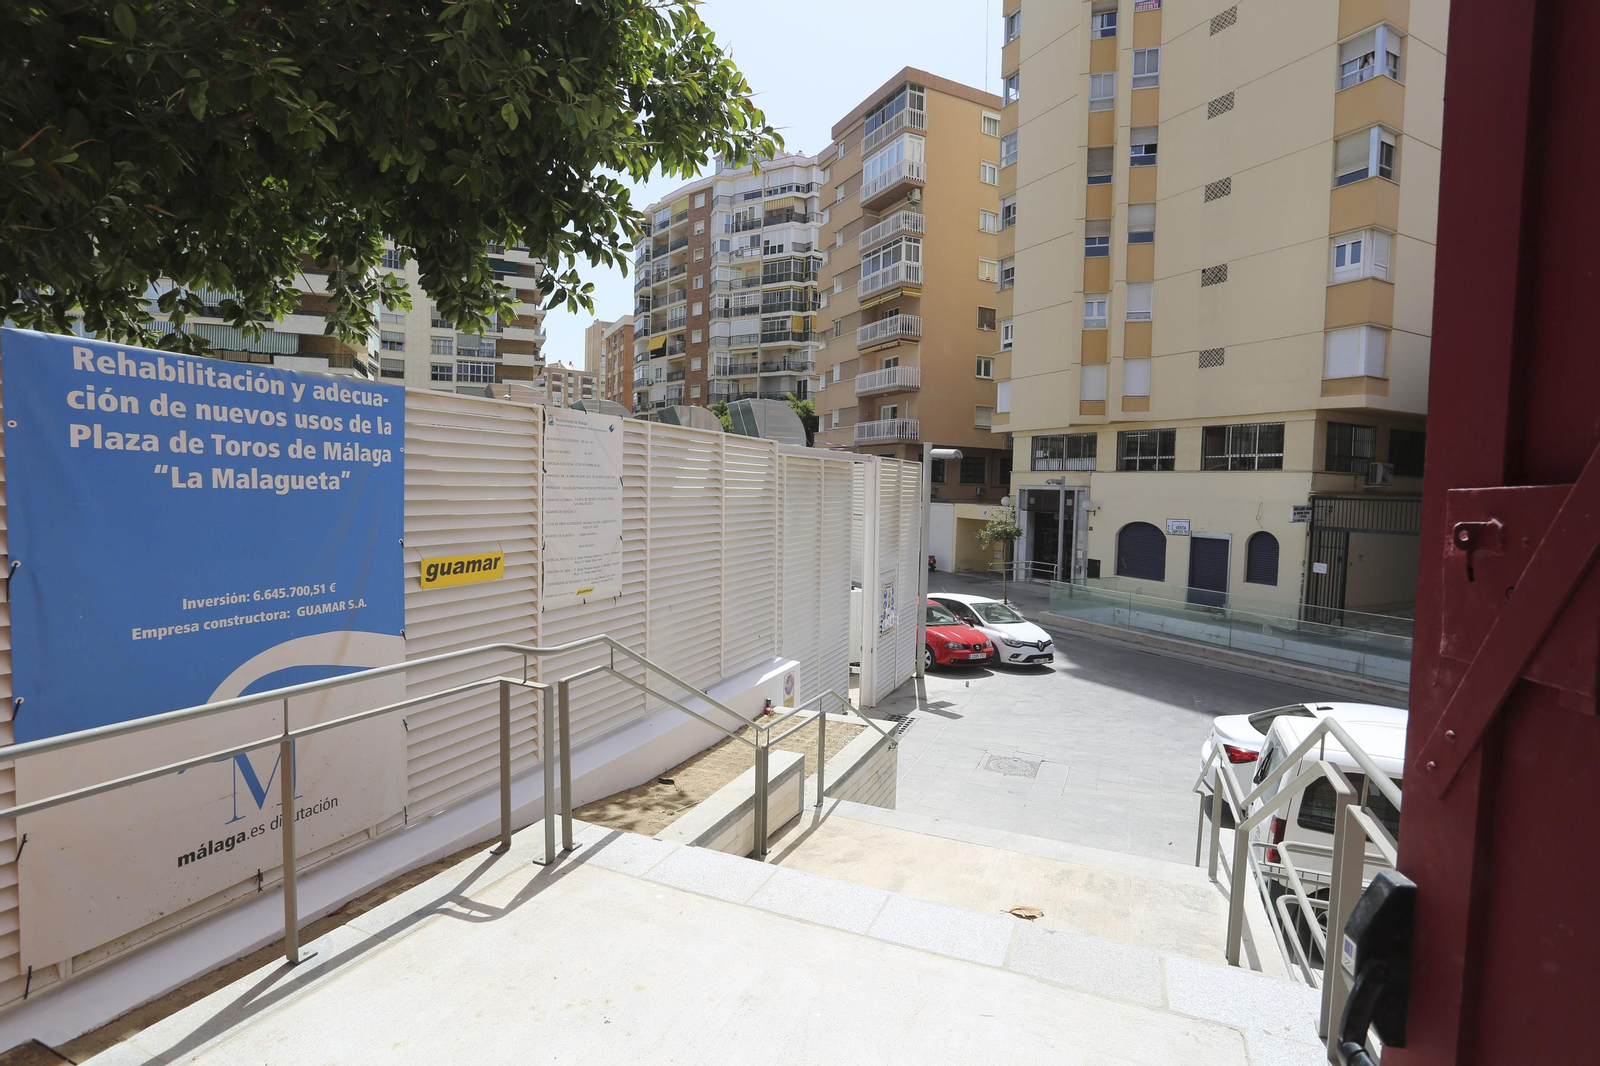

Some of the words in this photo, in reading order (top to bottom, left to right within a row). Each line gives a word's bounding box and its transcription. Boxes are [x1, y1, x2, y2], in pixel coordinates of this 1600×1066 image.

[72, 345, 285, 396] Rehabilitación
[292, 381, 306, 402] y
[312, 382, 389, 407] adecua-
[66, 385, 140, 414] ción
[150, 393, 187, 418] de
[195, 403, 287, 427] nuevos
[295, 413, 344, 431] usos
[349, 414, 372, 434] de
[377, 416, 392, 436] la
[69, 423, 160, 452] Plaza
[169, 430, 204, 455] de
[211, 434, 280, 458] Toros
[287, 439, 317, 460] de
[323, 441, 392, 467] Málaga
[426, 557, 501, 583] guamar
[182, 591, 251, 611] Inversión:
[252, 583, 326, 603] 6.645.700,51
[329, 582, 337, 593] €
[131, 619, 200, 641] Empresa
[203, 609, 291, 631] constructora:
[296, 600, 346, 618] GUAMAR
[348, 598, 367, 611] S.A.
[177, 823, 266, 868] málaga.es
